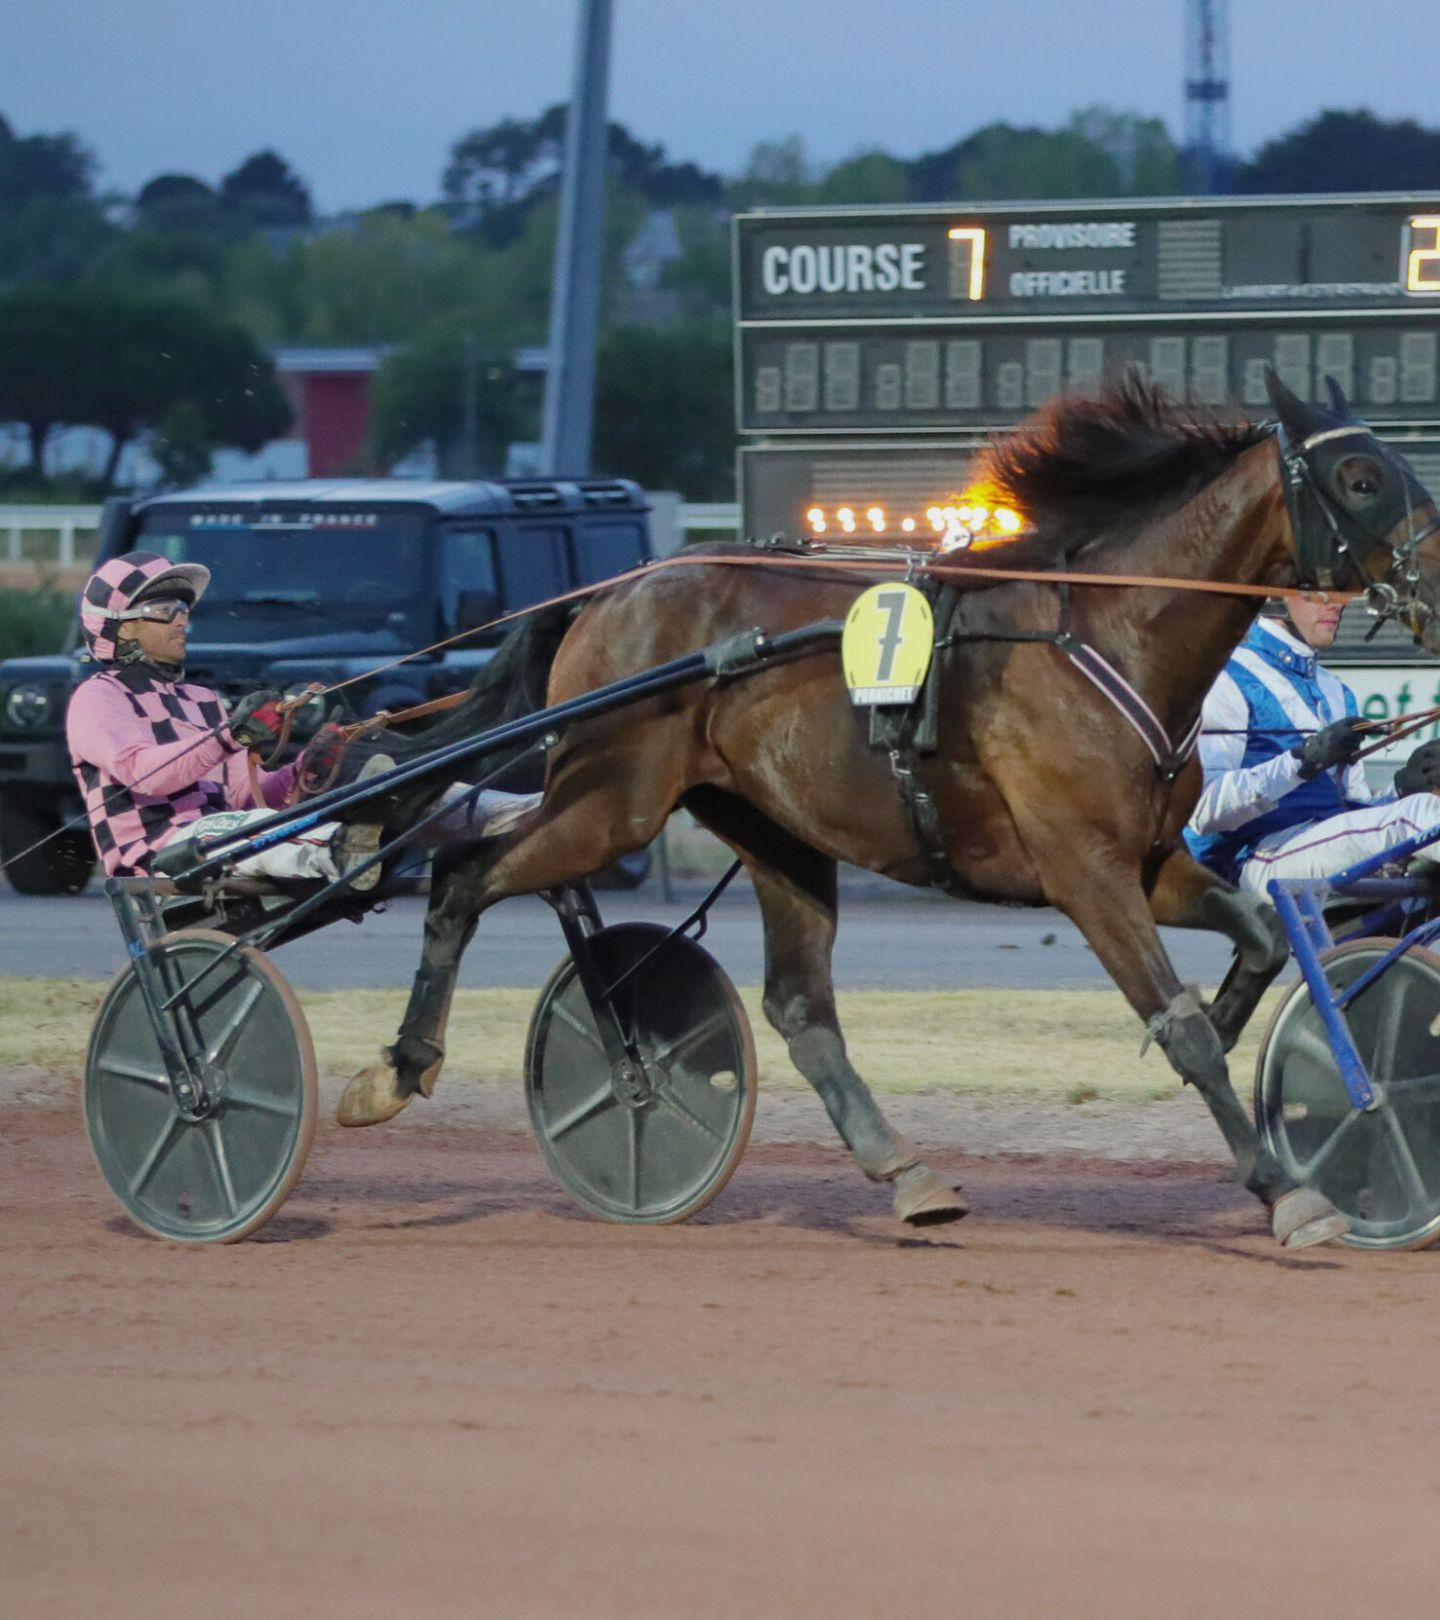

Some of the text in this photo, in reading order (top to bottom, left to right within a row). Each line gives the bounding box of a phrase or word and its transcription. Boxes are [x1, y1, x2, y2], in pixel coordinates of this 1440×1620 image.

[1009, 222, 1137, 249] PROVISOIRE
[763, 228, 986, 301] COURSE 7
[1010, 270, 1126, 297] OFFICIELLE
[191, 513, 243, 526] MADE
[300, 512, 377, 526] FRANCE
[876, 589, 907, 682] 7
[855, 686, 913, 704] PORNICHET
